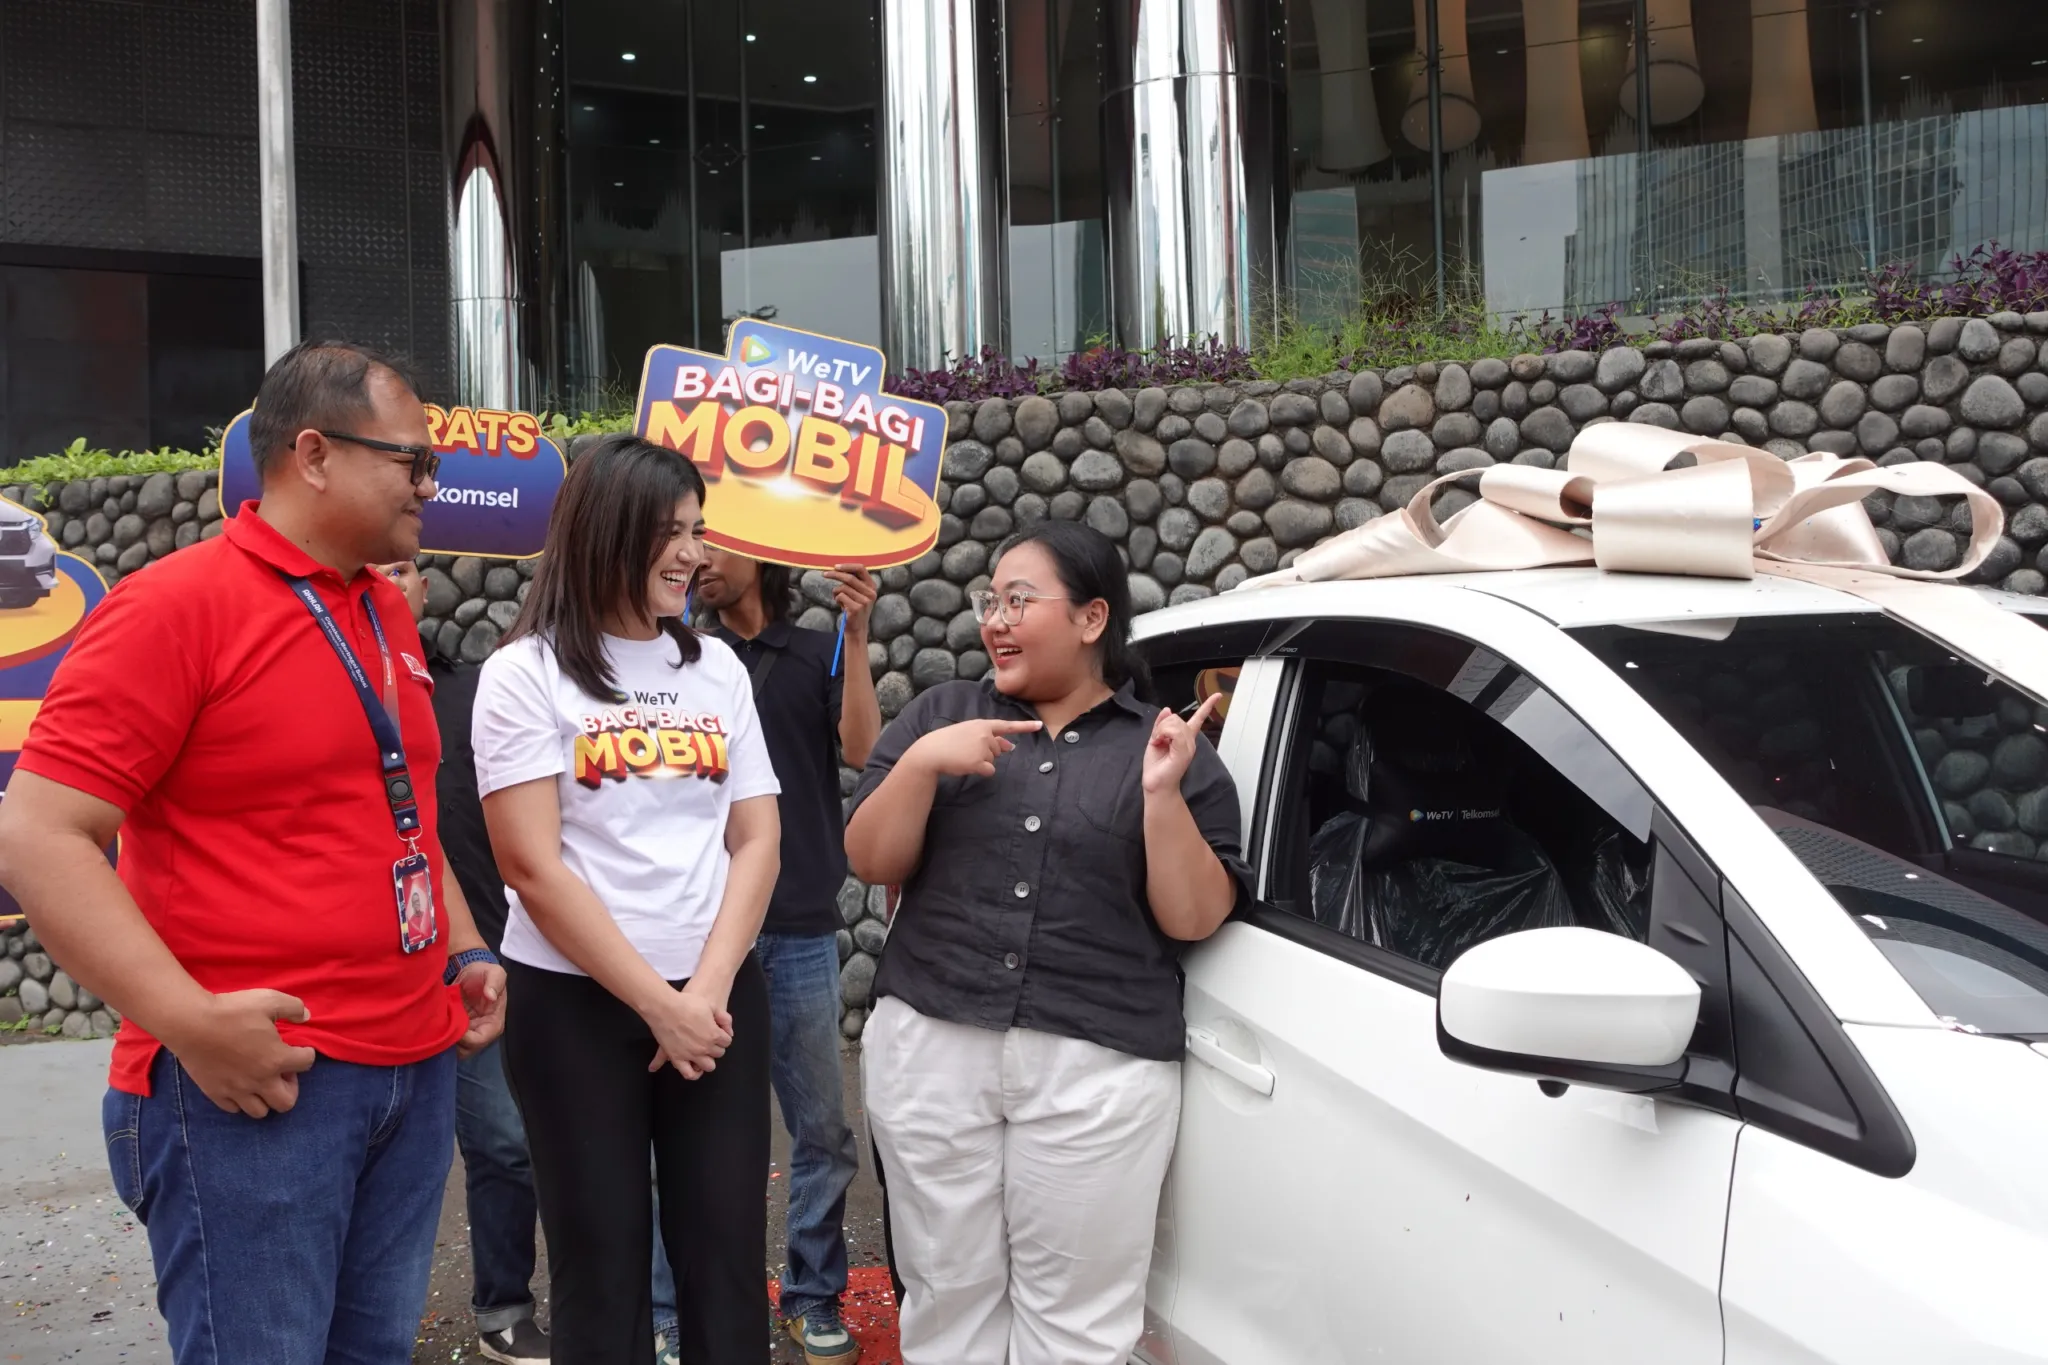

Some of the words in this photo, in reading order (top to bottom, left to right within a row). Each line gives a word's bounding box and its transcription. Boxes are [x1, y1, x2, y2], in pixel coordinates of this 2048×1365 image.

[788, 348, 871, 386] WeTV
[673, 365, 925, 452] BAGI-BAGI
[645, 401, 926, 522] MOBIL
[428, 481, 519, 508] komsel
[634, 690, 679, 706] WeTV
[580, 706, 729, 735] BAGI-BAGI
[1426, 811, 1454, 820] WeTV
[1461, 808, 1500, 819] Telkomsel
